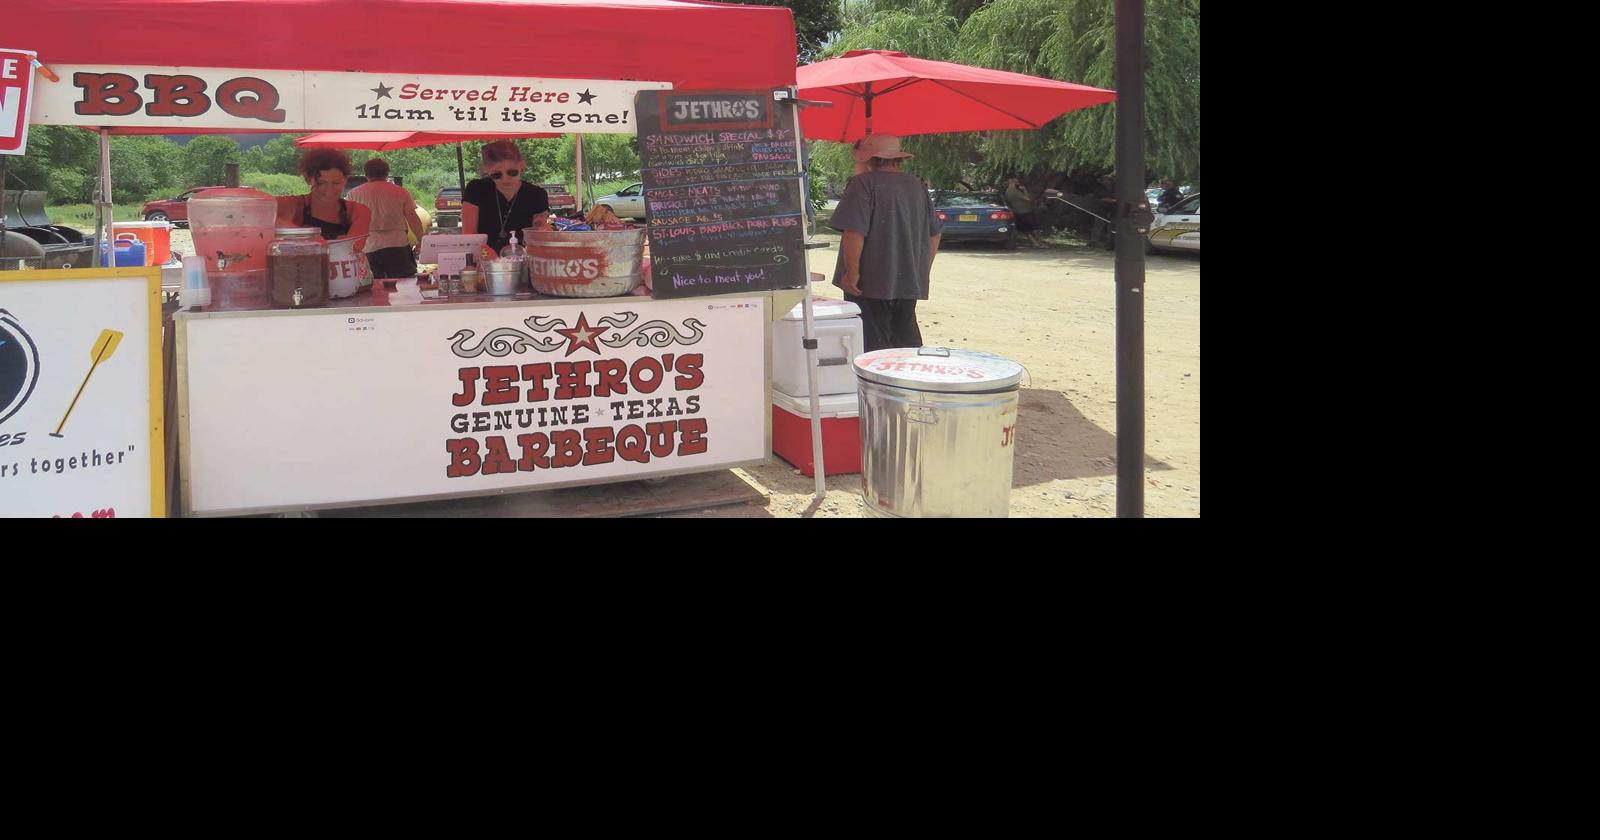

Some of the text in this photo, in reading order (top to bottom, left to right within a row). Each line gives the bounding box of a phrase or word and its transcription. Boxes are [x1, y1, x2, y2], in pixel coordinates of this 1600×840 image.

[73, 71, 286, 123] BBQ
[399, 83, 570, 104] Served Here
[355, 104, 629, 128] 11am 'til it's gone!
[675, 100, 760, 120] JETHRO'S
[646, 133, 715, 147] SANDWICH
[719, 131, 763, 142] SPECIAL
[688, 186, 721, 197] MEATS
[651, 216, 691, 227] SAUSAGE
[672, 268, 766, 288] Nice to meat you!
[452, 353, 705, 407] JETHRO'S
[450, 395, 702, 434] GENUINE TEXAS
[446, 418, 708, 478] BARBEQUE
